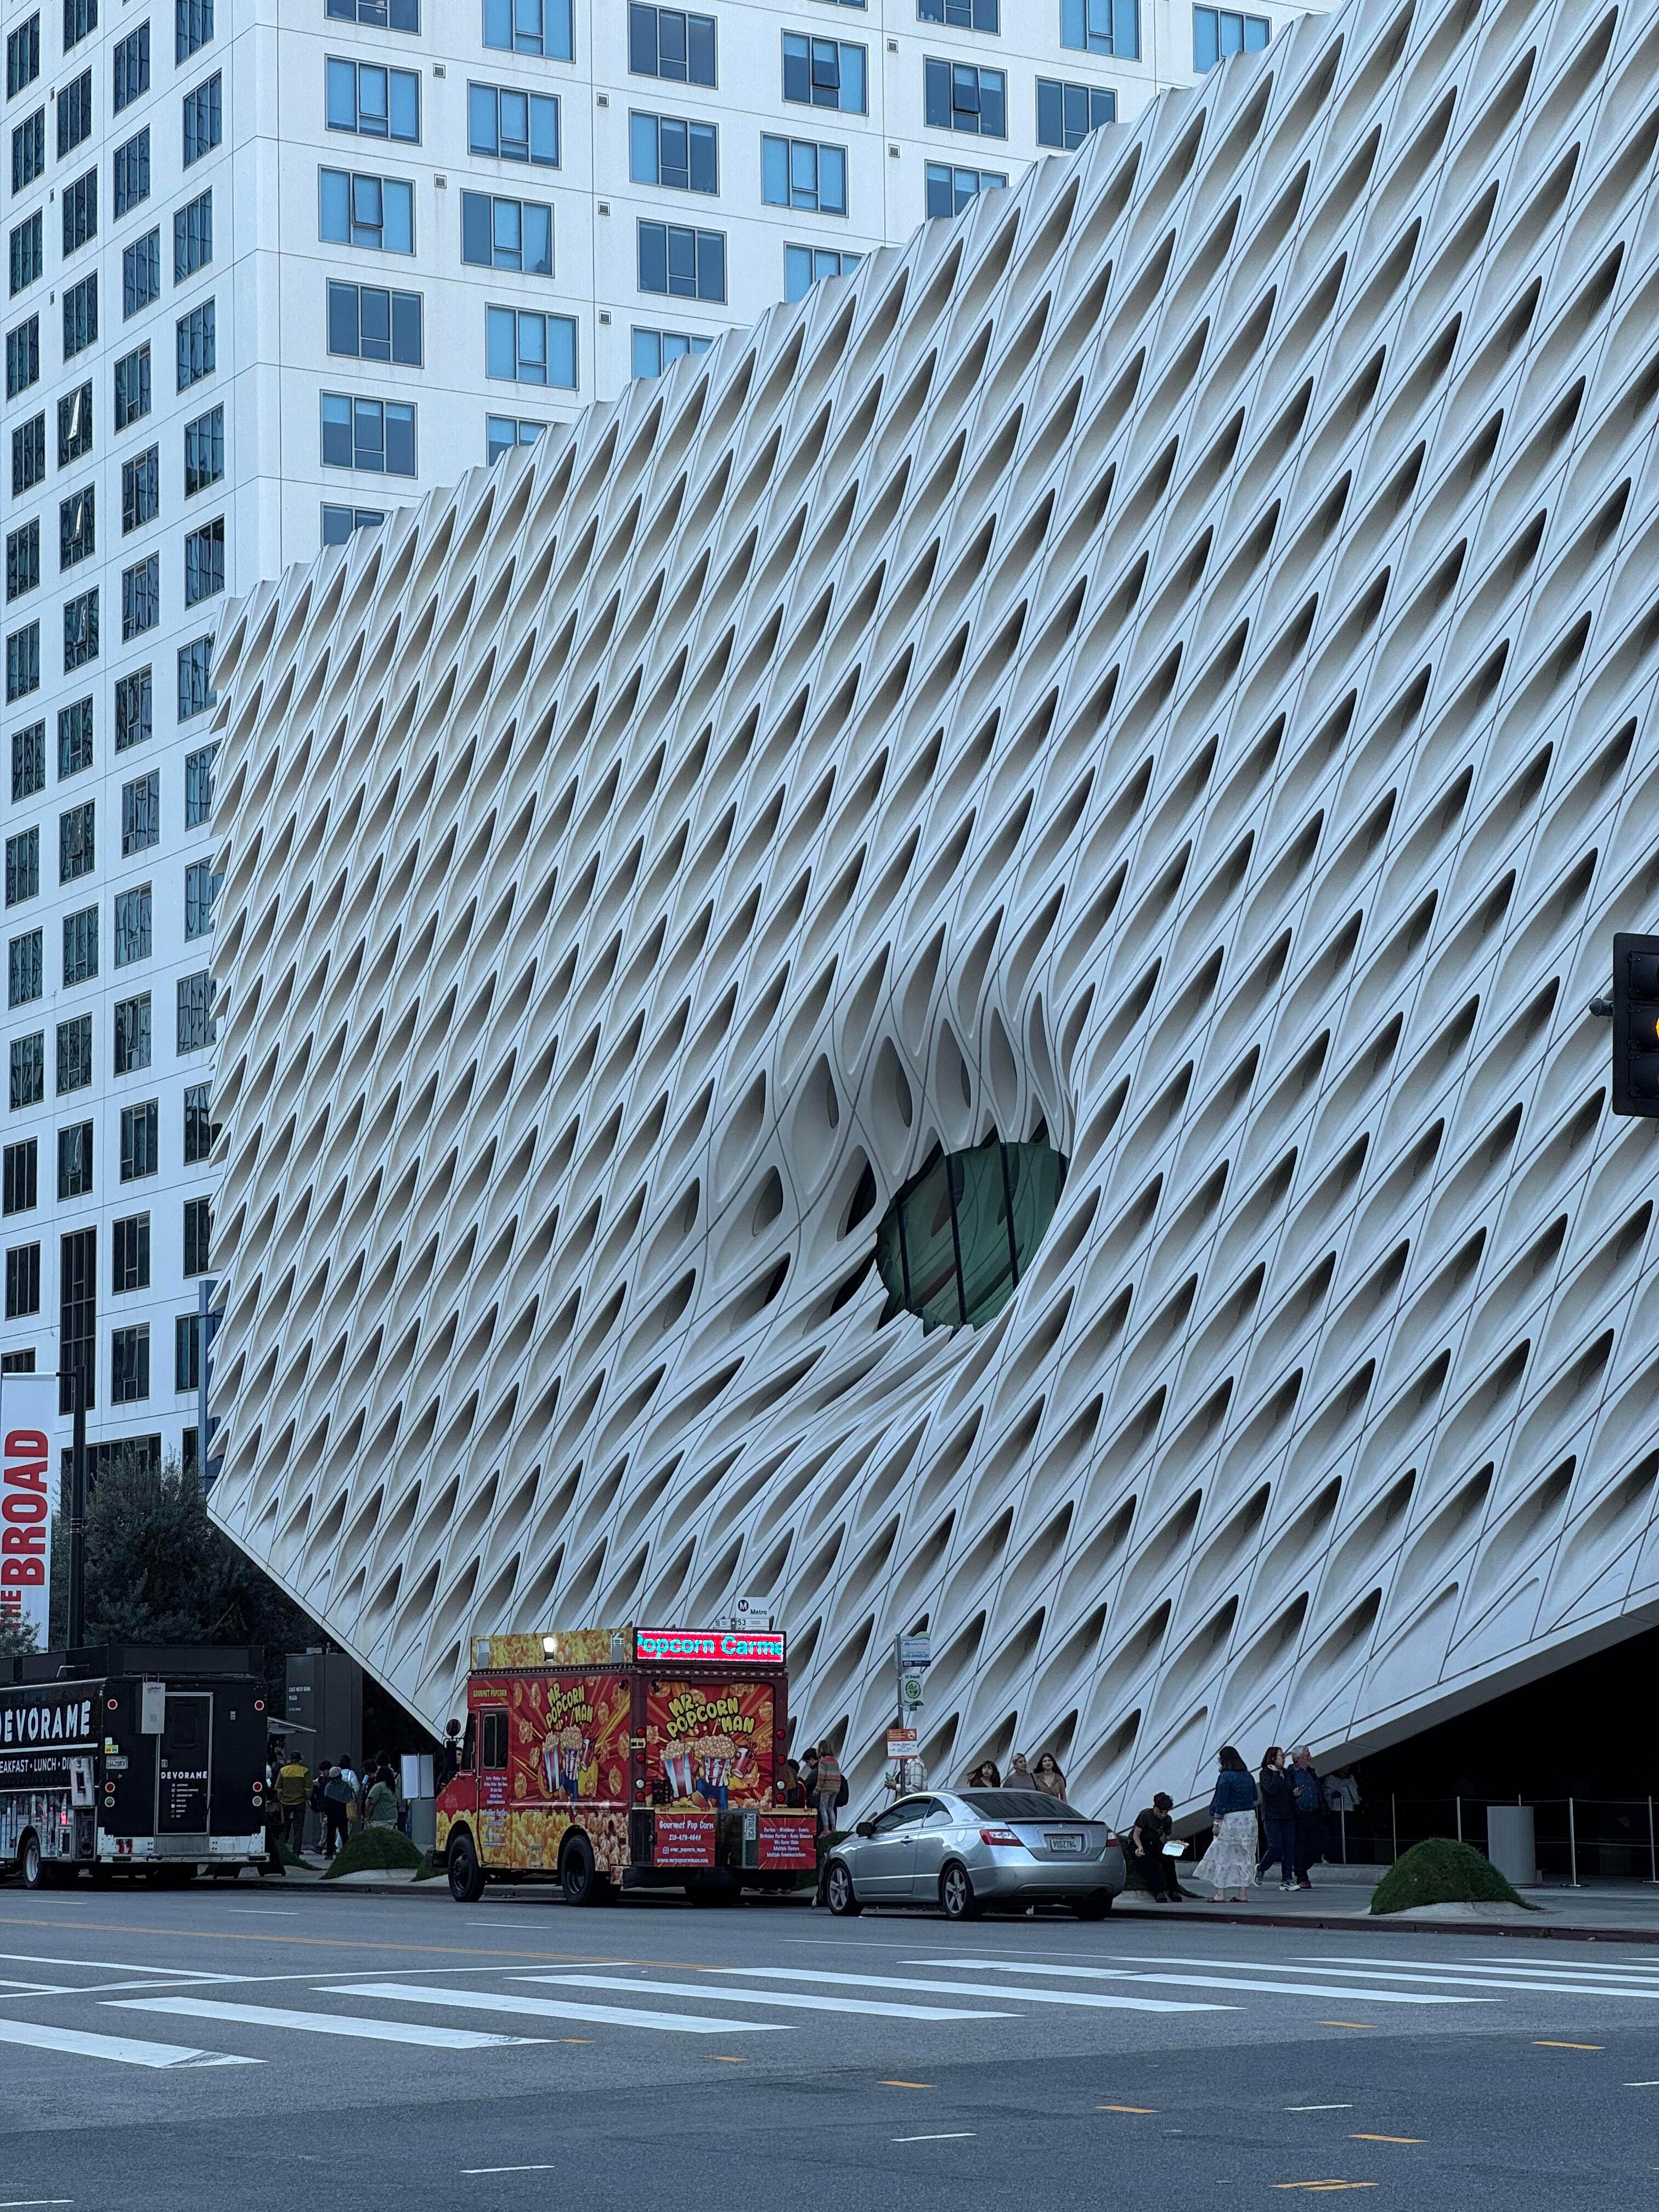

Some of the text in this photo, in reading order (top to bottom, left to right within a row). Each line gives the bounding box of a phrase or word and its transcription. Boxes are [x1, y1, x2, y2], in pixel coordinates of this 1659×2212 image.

[1, 1430, 48, 1585] BROAD
[546, 1684, 585, 1729] POPCORN
[548, 1682, 563, 1708] MR.
[668, 1693, 699, 1718] MR.
[0, 1700, 91, 1742] EVORAME
[575, 1705, 594, 1724] MAN
[666, 1697, 739, 1738] POPCORN
[721, 1715, 755, 1734] MAN
[33, 1757, 57, 1771] LUNCH
[161, 1771, 207, 1779] DEVORAME
[659, 1820, 714, 1831] Gourmet Pop Corn
